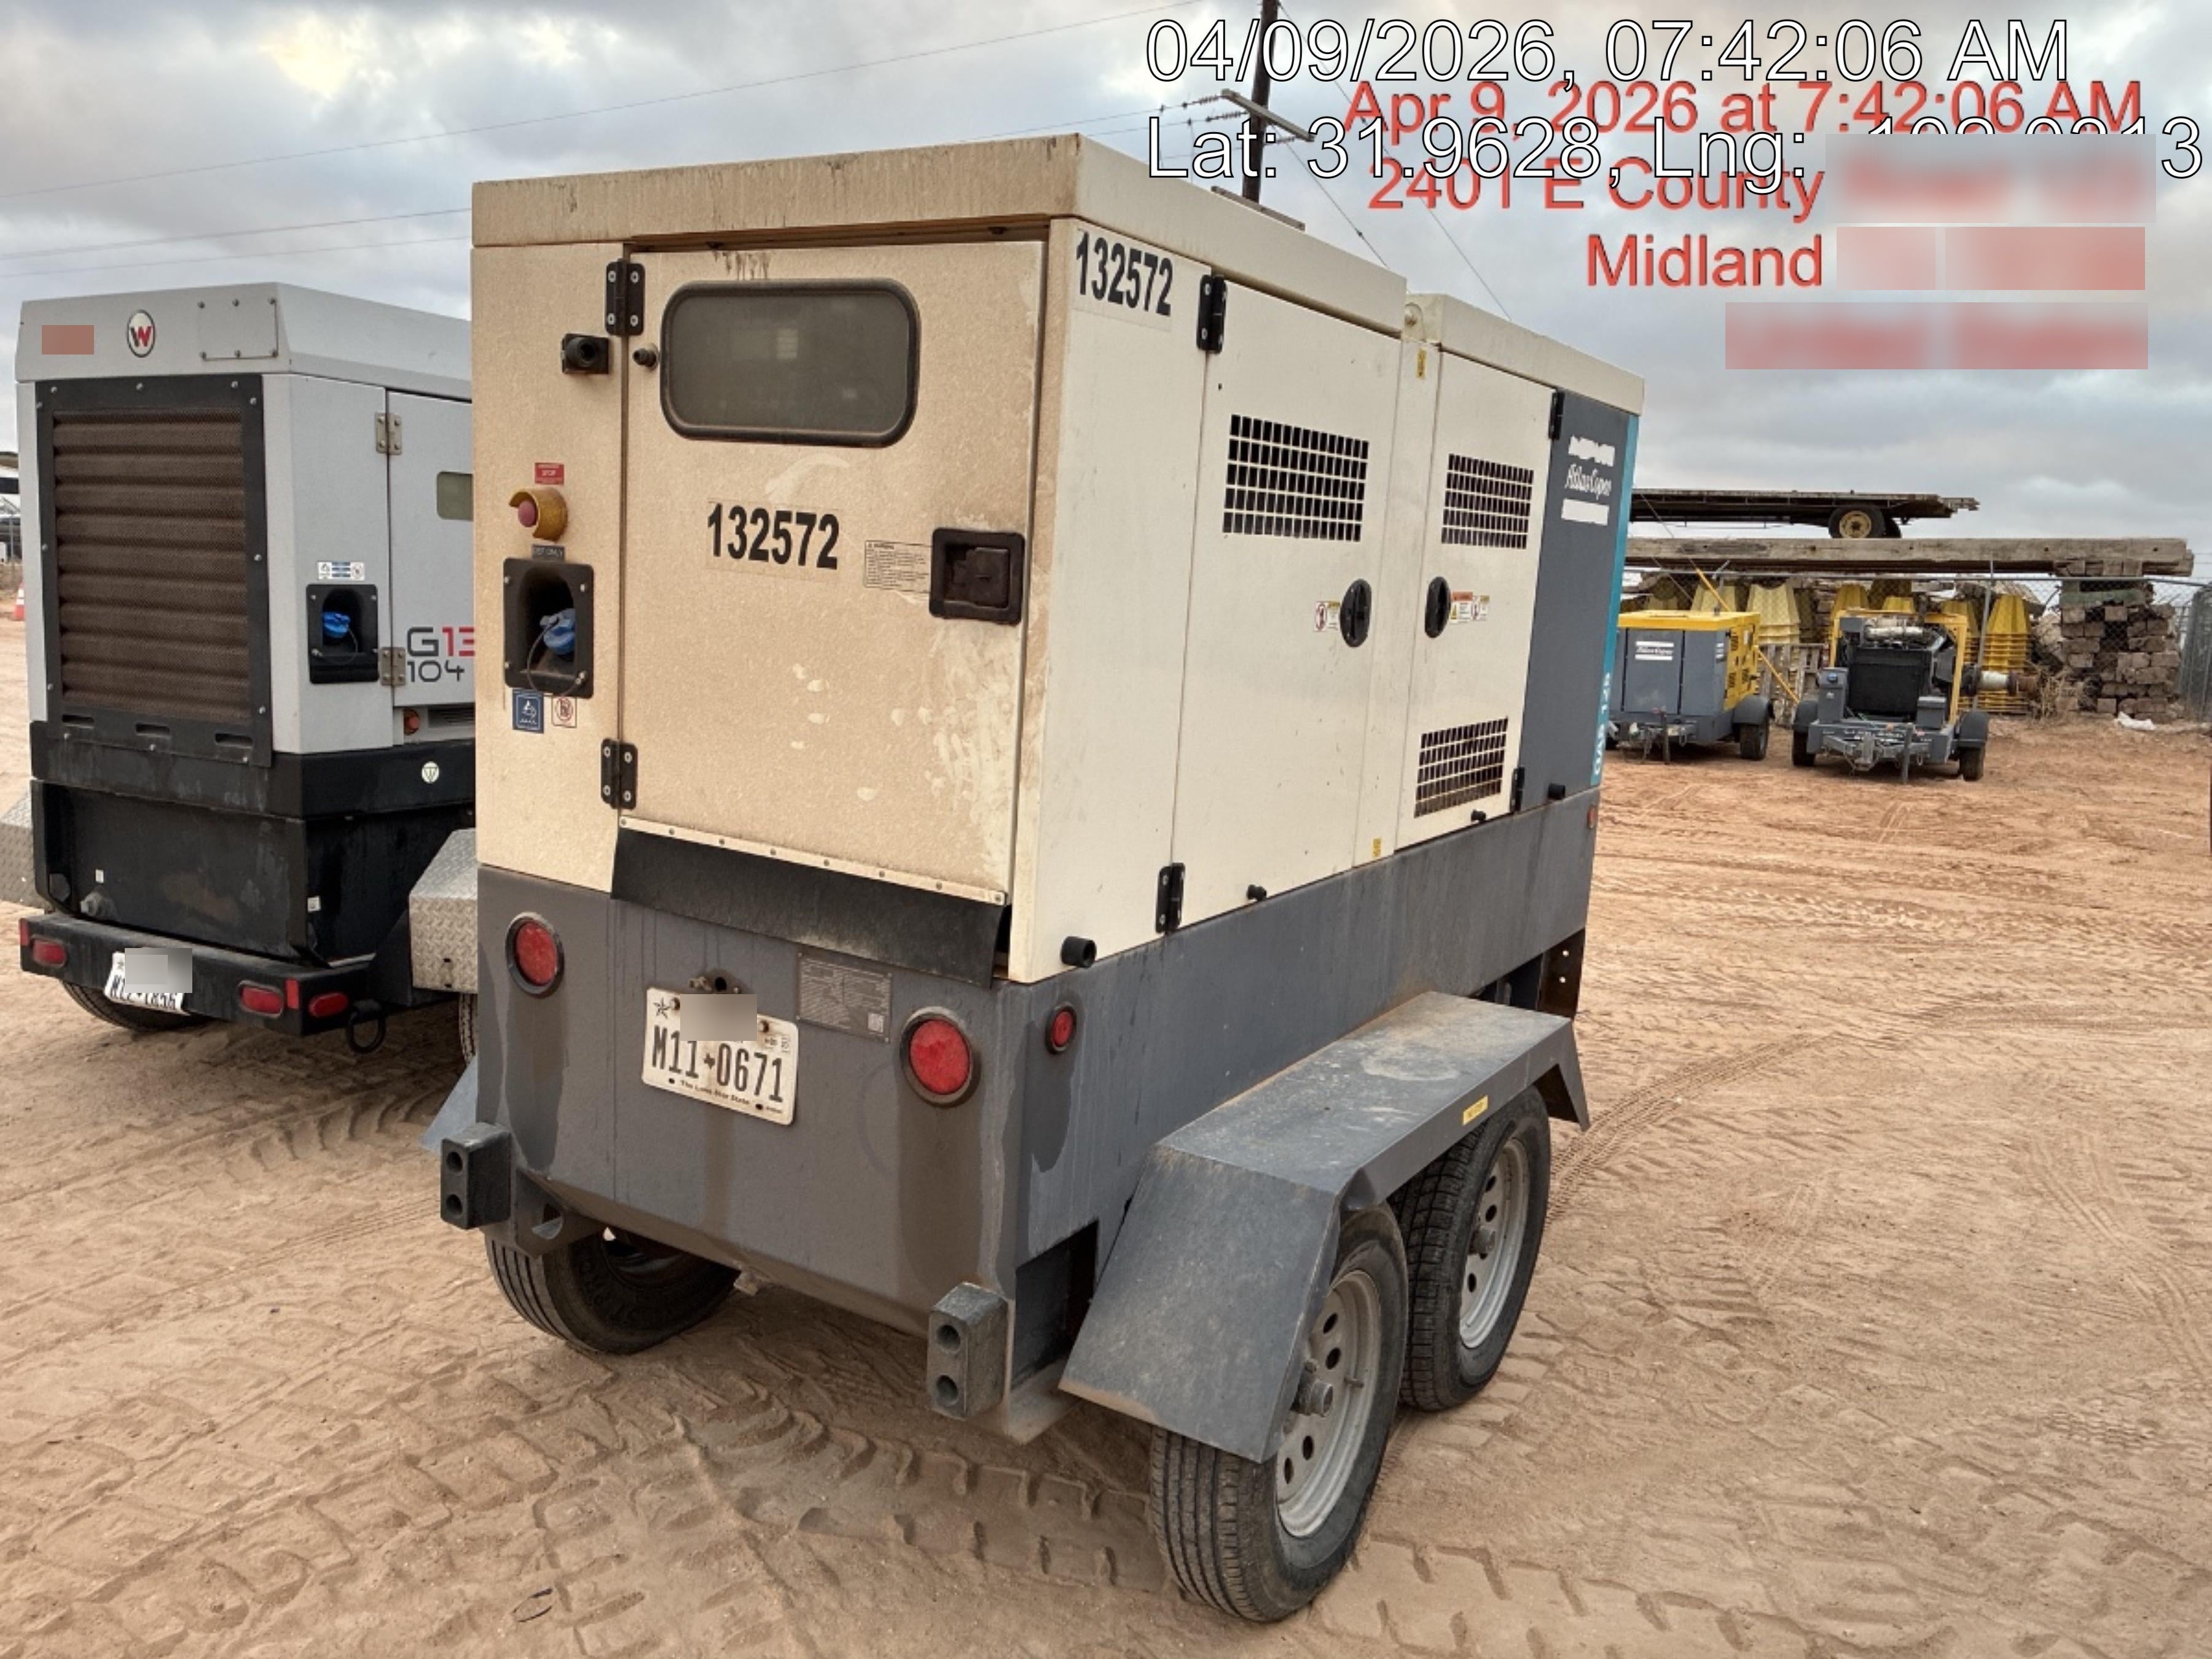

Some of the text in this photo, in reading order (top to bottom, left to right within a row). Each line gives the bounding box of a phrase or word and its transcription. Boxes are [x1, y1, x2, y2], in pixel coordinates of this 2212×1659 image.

[1077, 232, 1173, 317] 132572
[707, 503, 840, 570] 132572
[407, 660, 465, 683] 104
[716, 1043, 784, 1103] 0671
